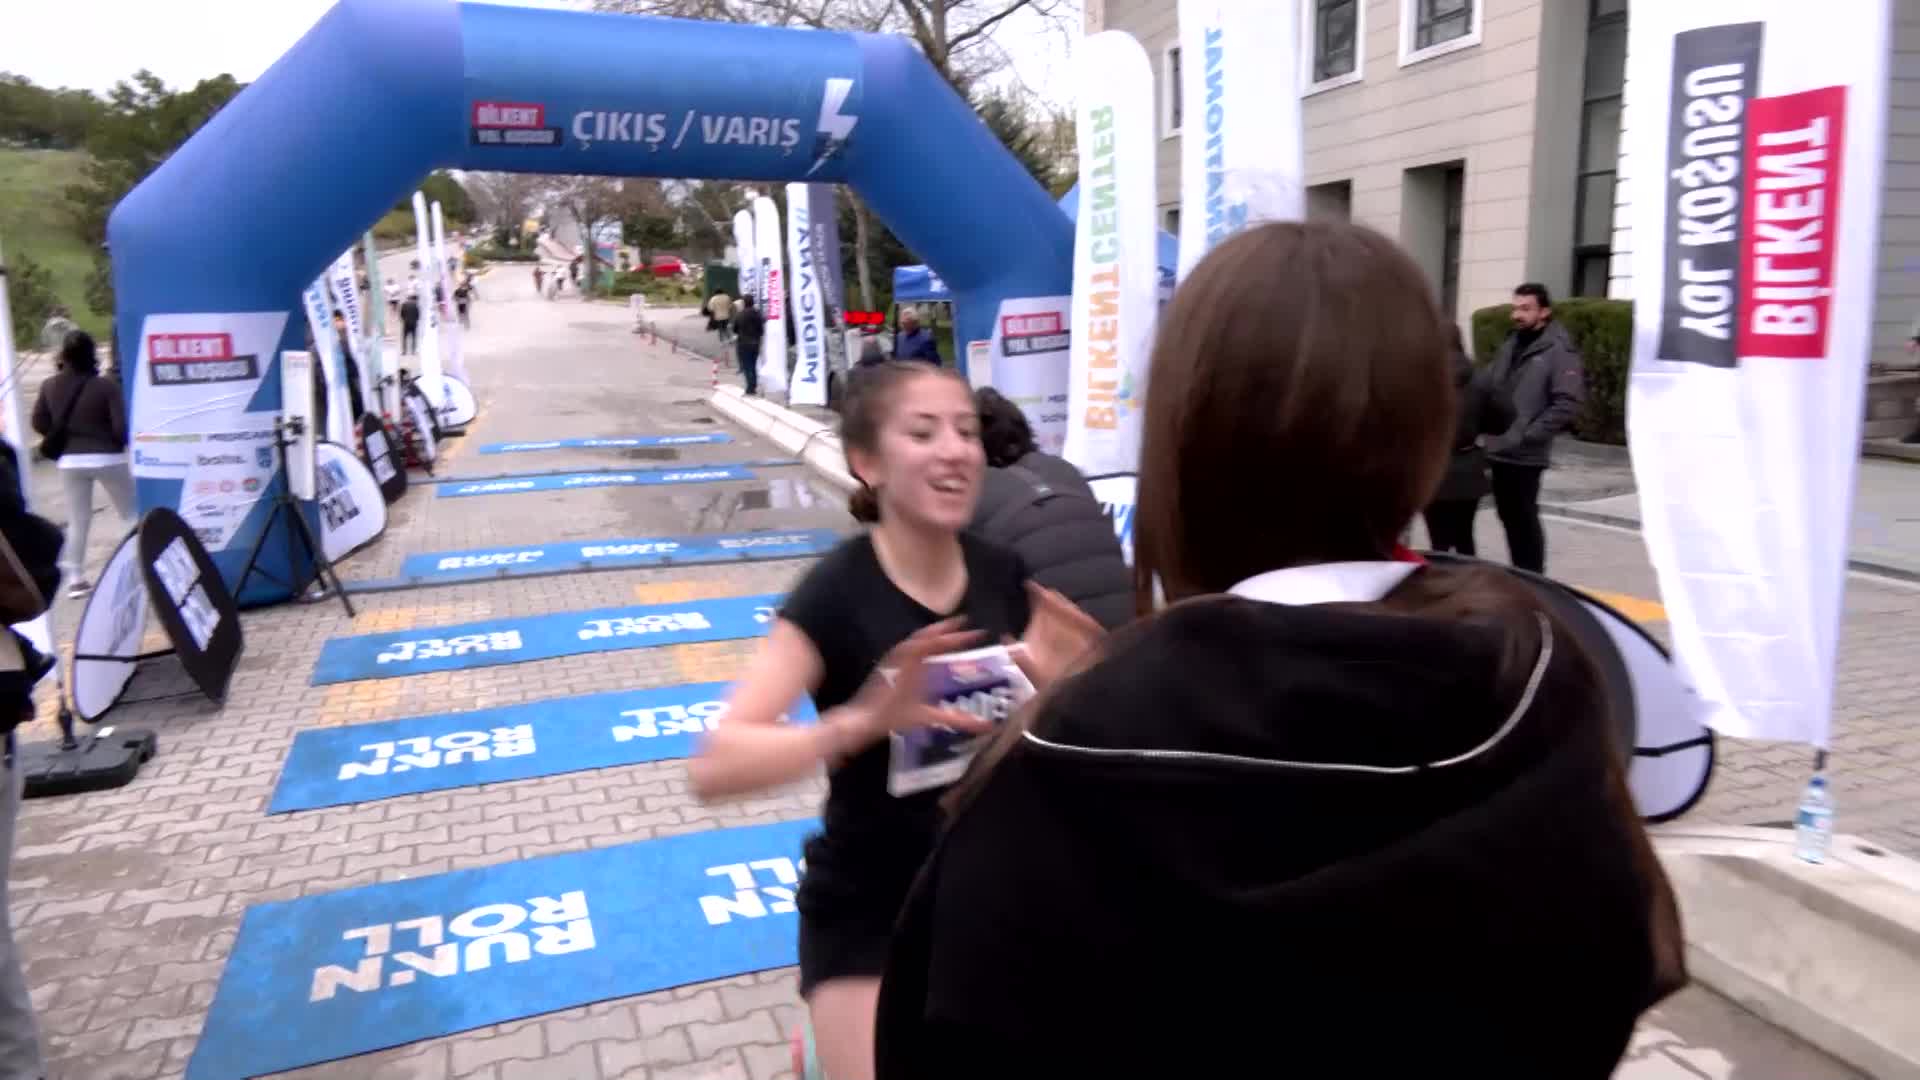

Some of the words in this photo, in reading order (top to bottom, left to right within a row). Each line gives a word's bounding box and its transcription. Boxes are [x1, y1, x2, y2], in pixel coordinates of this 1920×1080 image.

[572, 110, 666, 153] ÇIKIŞ
[671, 109, 694, 151] /
[702, 116, 801, 157] VARIŞ
[620, 701, 730, 721] OLL
[360, 723, 533, 759] ROLL
[342, 890, 589, 956] ROLL
